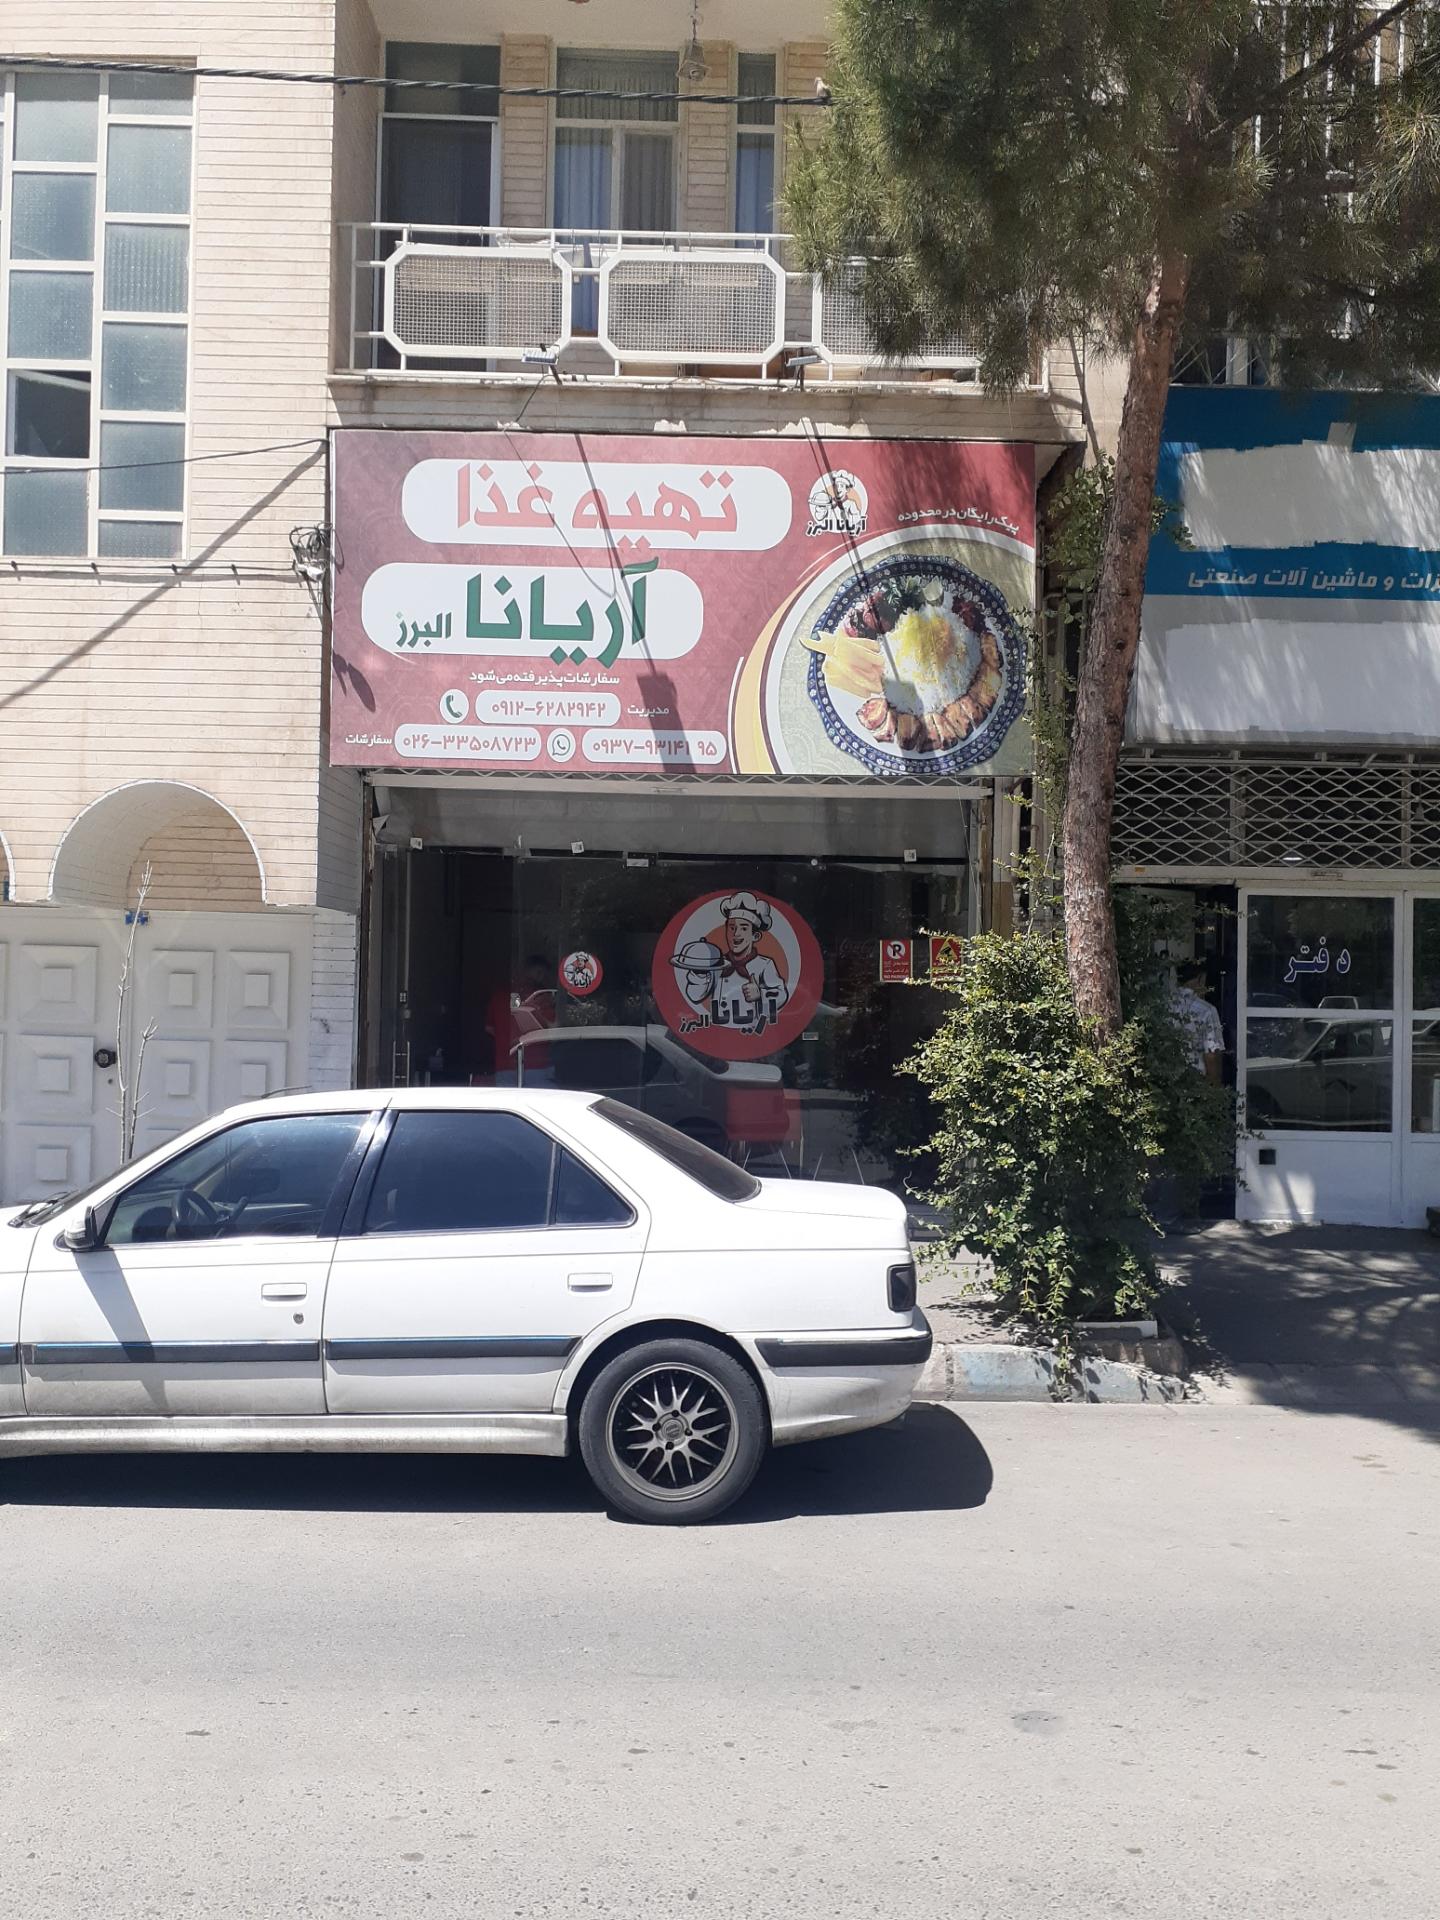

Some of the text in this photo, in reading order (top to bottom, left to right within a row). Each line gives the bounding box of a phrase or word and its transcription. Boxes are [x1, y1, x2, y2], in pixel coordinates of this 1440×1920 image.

[456, 462, 738, 551] تهیه غذا
[806, 514, 867, 538] آریانا البرز
[898, 506, 1020, 536] پیک رایگان در محدوده
[1187, 568, 1258, 589] صنعتی
[1263, 566, 1309, 587] آلات
[1311, 568, 1378, 592] ماشین
[1383, 576, 1395, 592] و
[395, 556, 659, 669] آریانا البرز
[514, 671, 564, 688] پذیرفته
[564, 672, 620, 687] سفارشات
[627, 704, 670, 718] مدیریت
[345, 734, 393, 748] سفارشات
[1283, 936, 1352, 983] دفتر
[679, 991, 780, 1036] آریانا البرز
